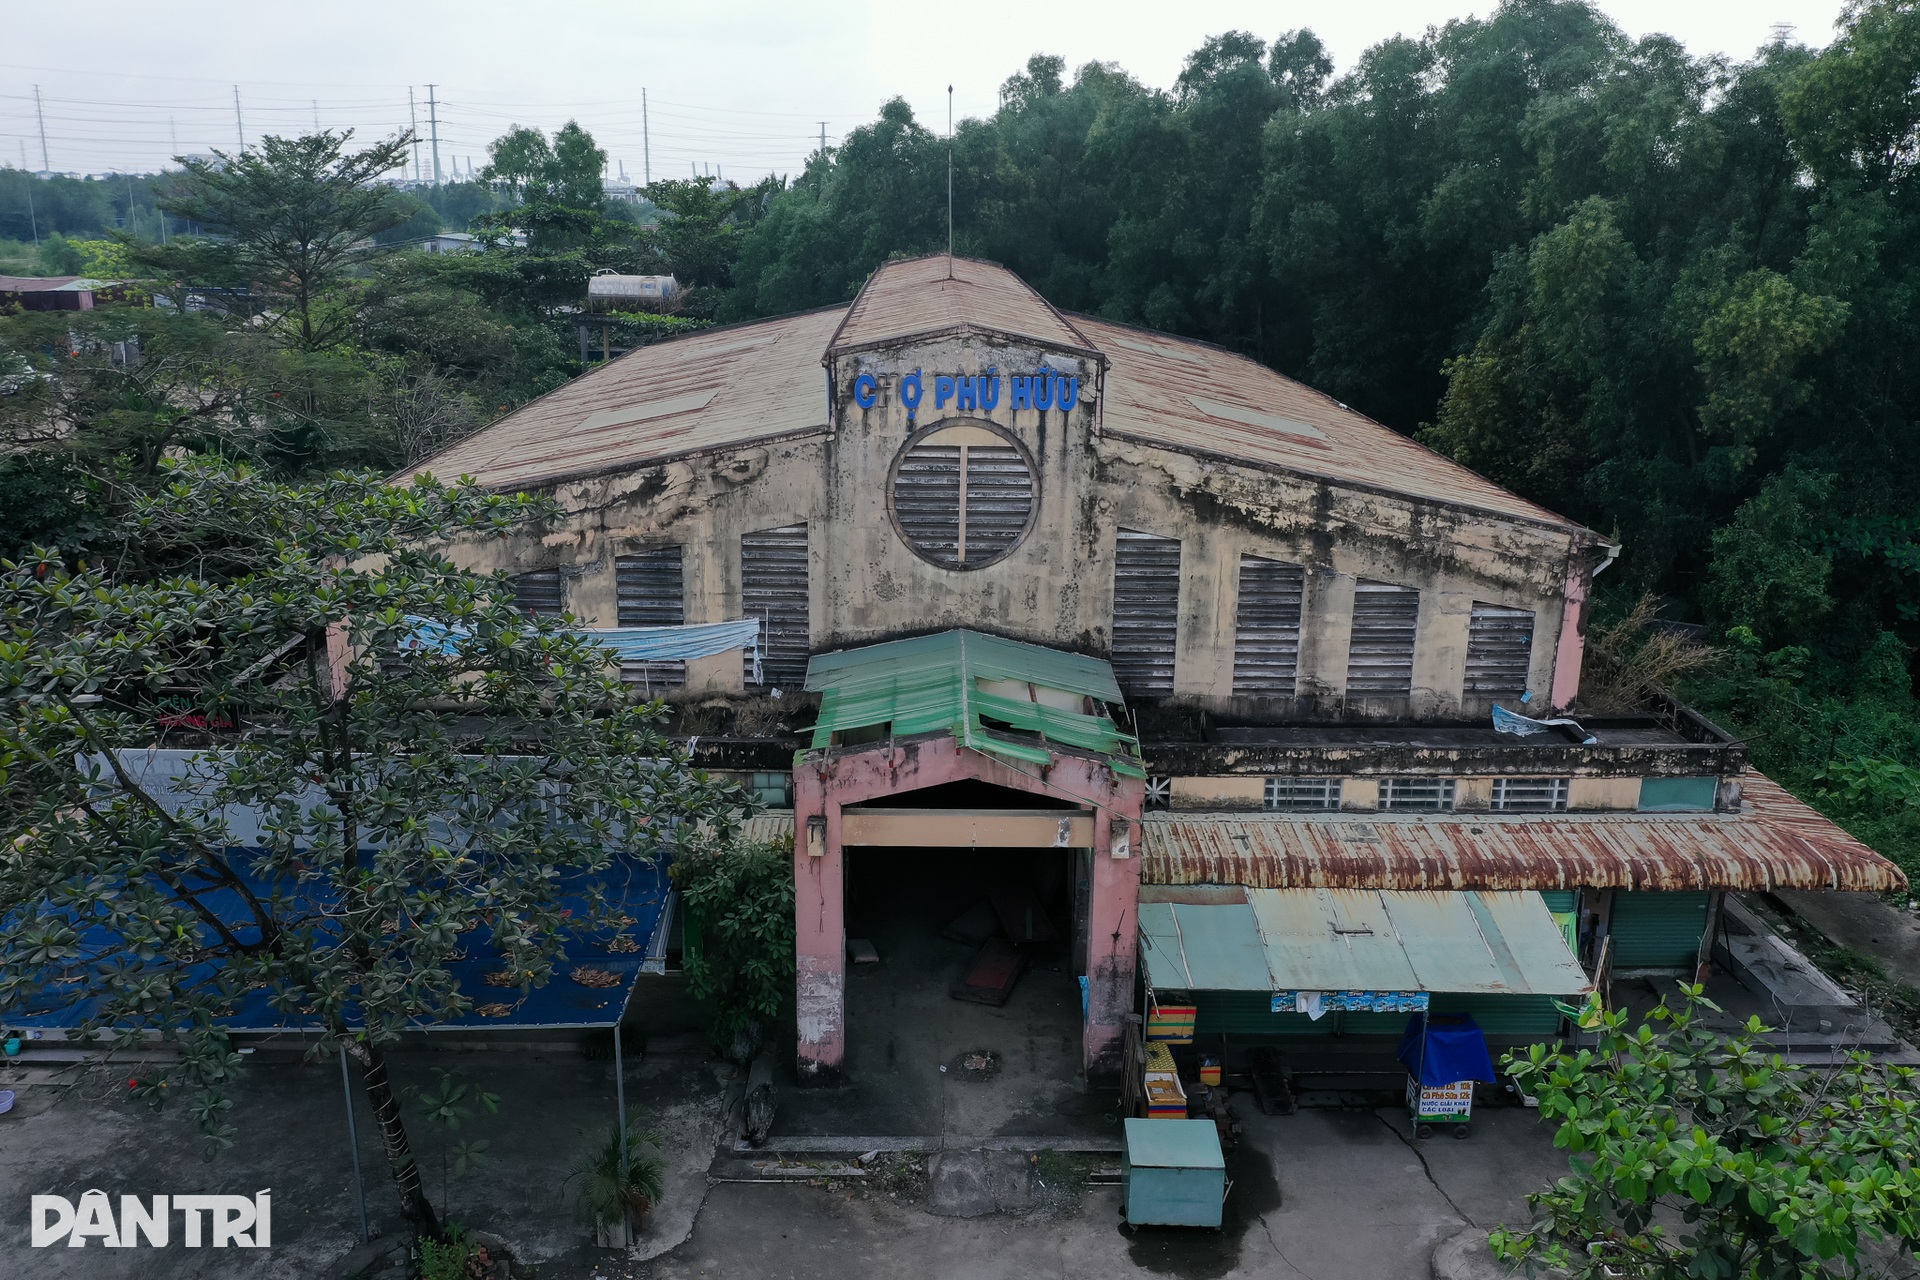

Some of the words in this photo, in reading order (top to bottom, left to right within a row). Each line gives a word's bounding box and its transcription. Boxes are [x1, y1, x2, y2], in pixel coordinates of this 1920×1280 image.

[935, 367, 1000, 411] PHÚ
[1011, 367, 1078, 411] HỮU
[1431, 1091, 1444, 1099] Phê
[1459, 1091, 1470, 1099] 12k
